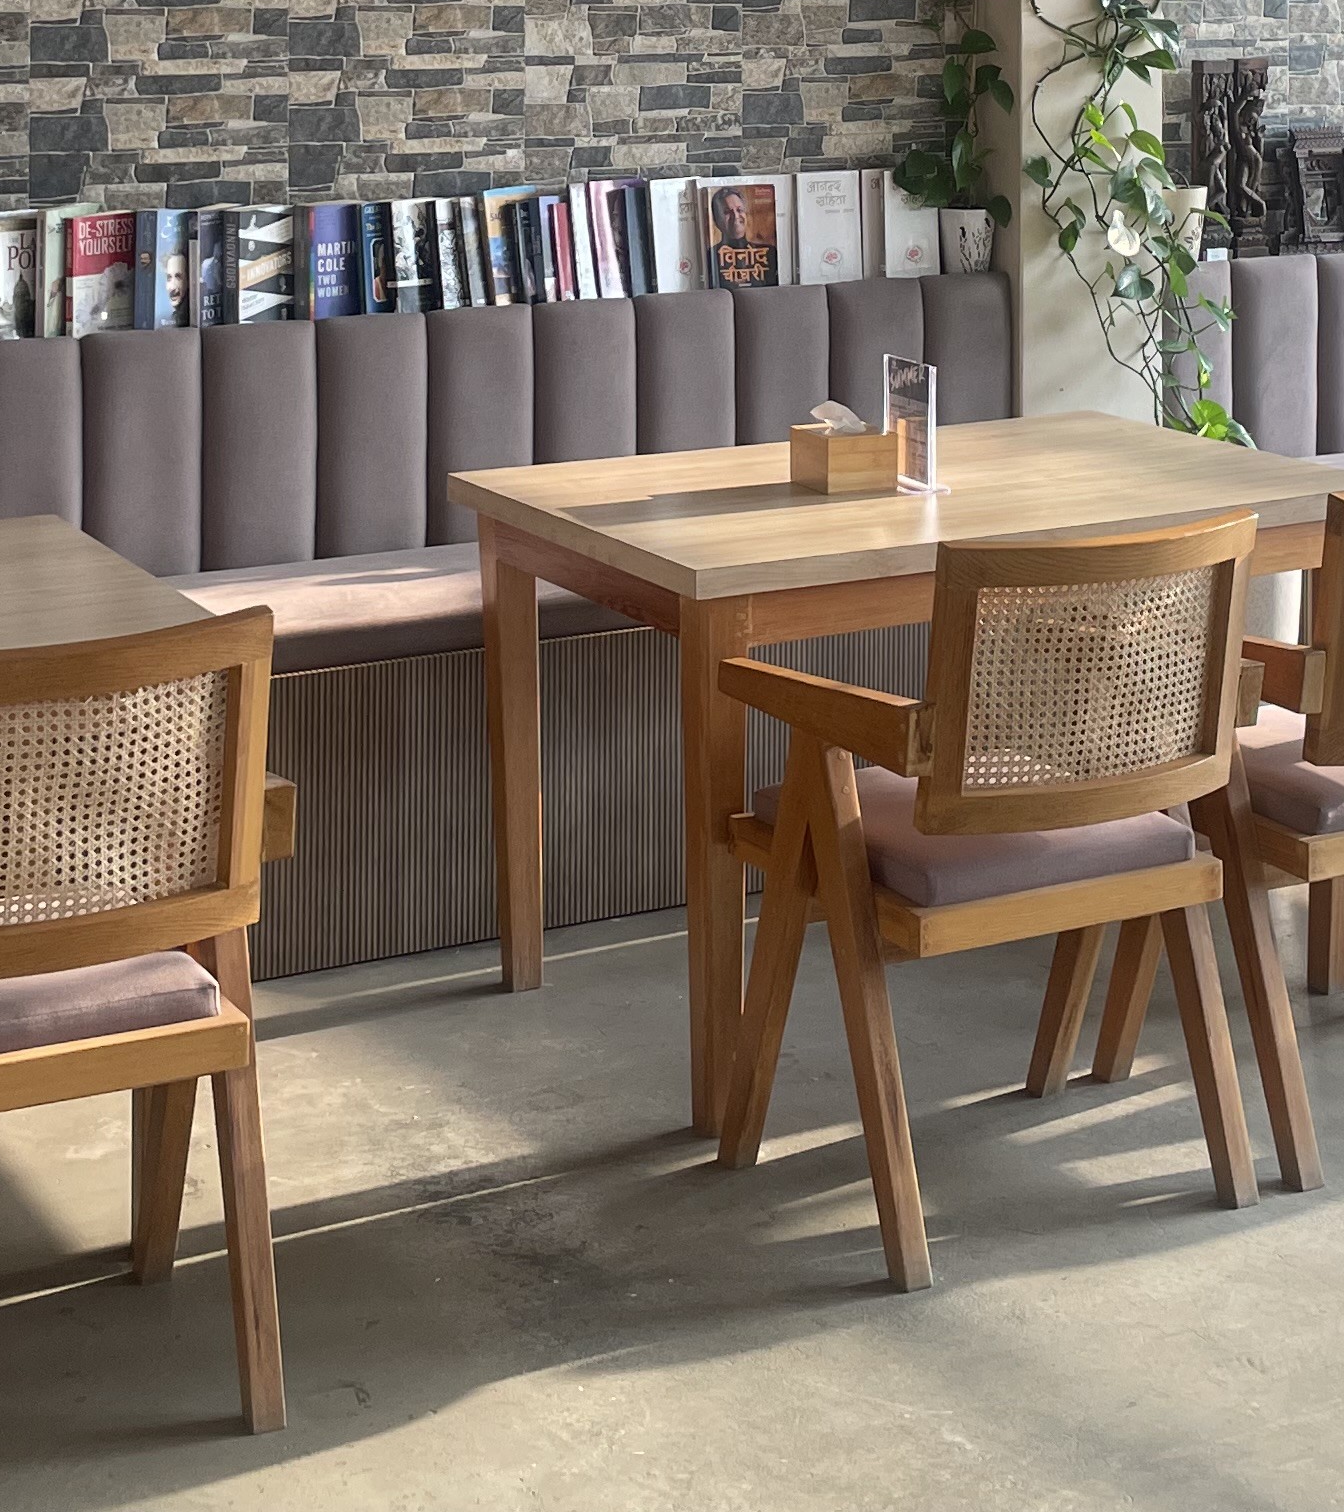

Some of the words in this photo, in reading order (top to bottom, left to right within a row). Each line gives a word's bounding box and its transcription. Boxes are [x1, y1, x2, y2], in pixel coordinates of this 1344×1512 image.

[78, 218, 134, 239] DE-STRESS
[78, 235, 134, 256] YOURSELF
[225, 223, 237, 289] INNOVATORS
[718, 244, 770, 266] विनोद
[317, 257, 346, 273] COLE
[317, 274, 337, 286] TWO
